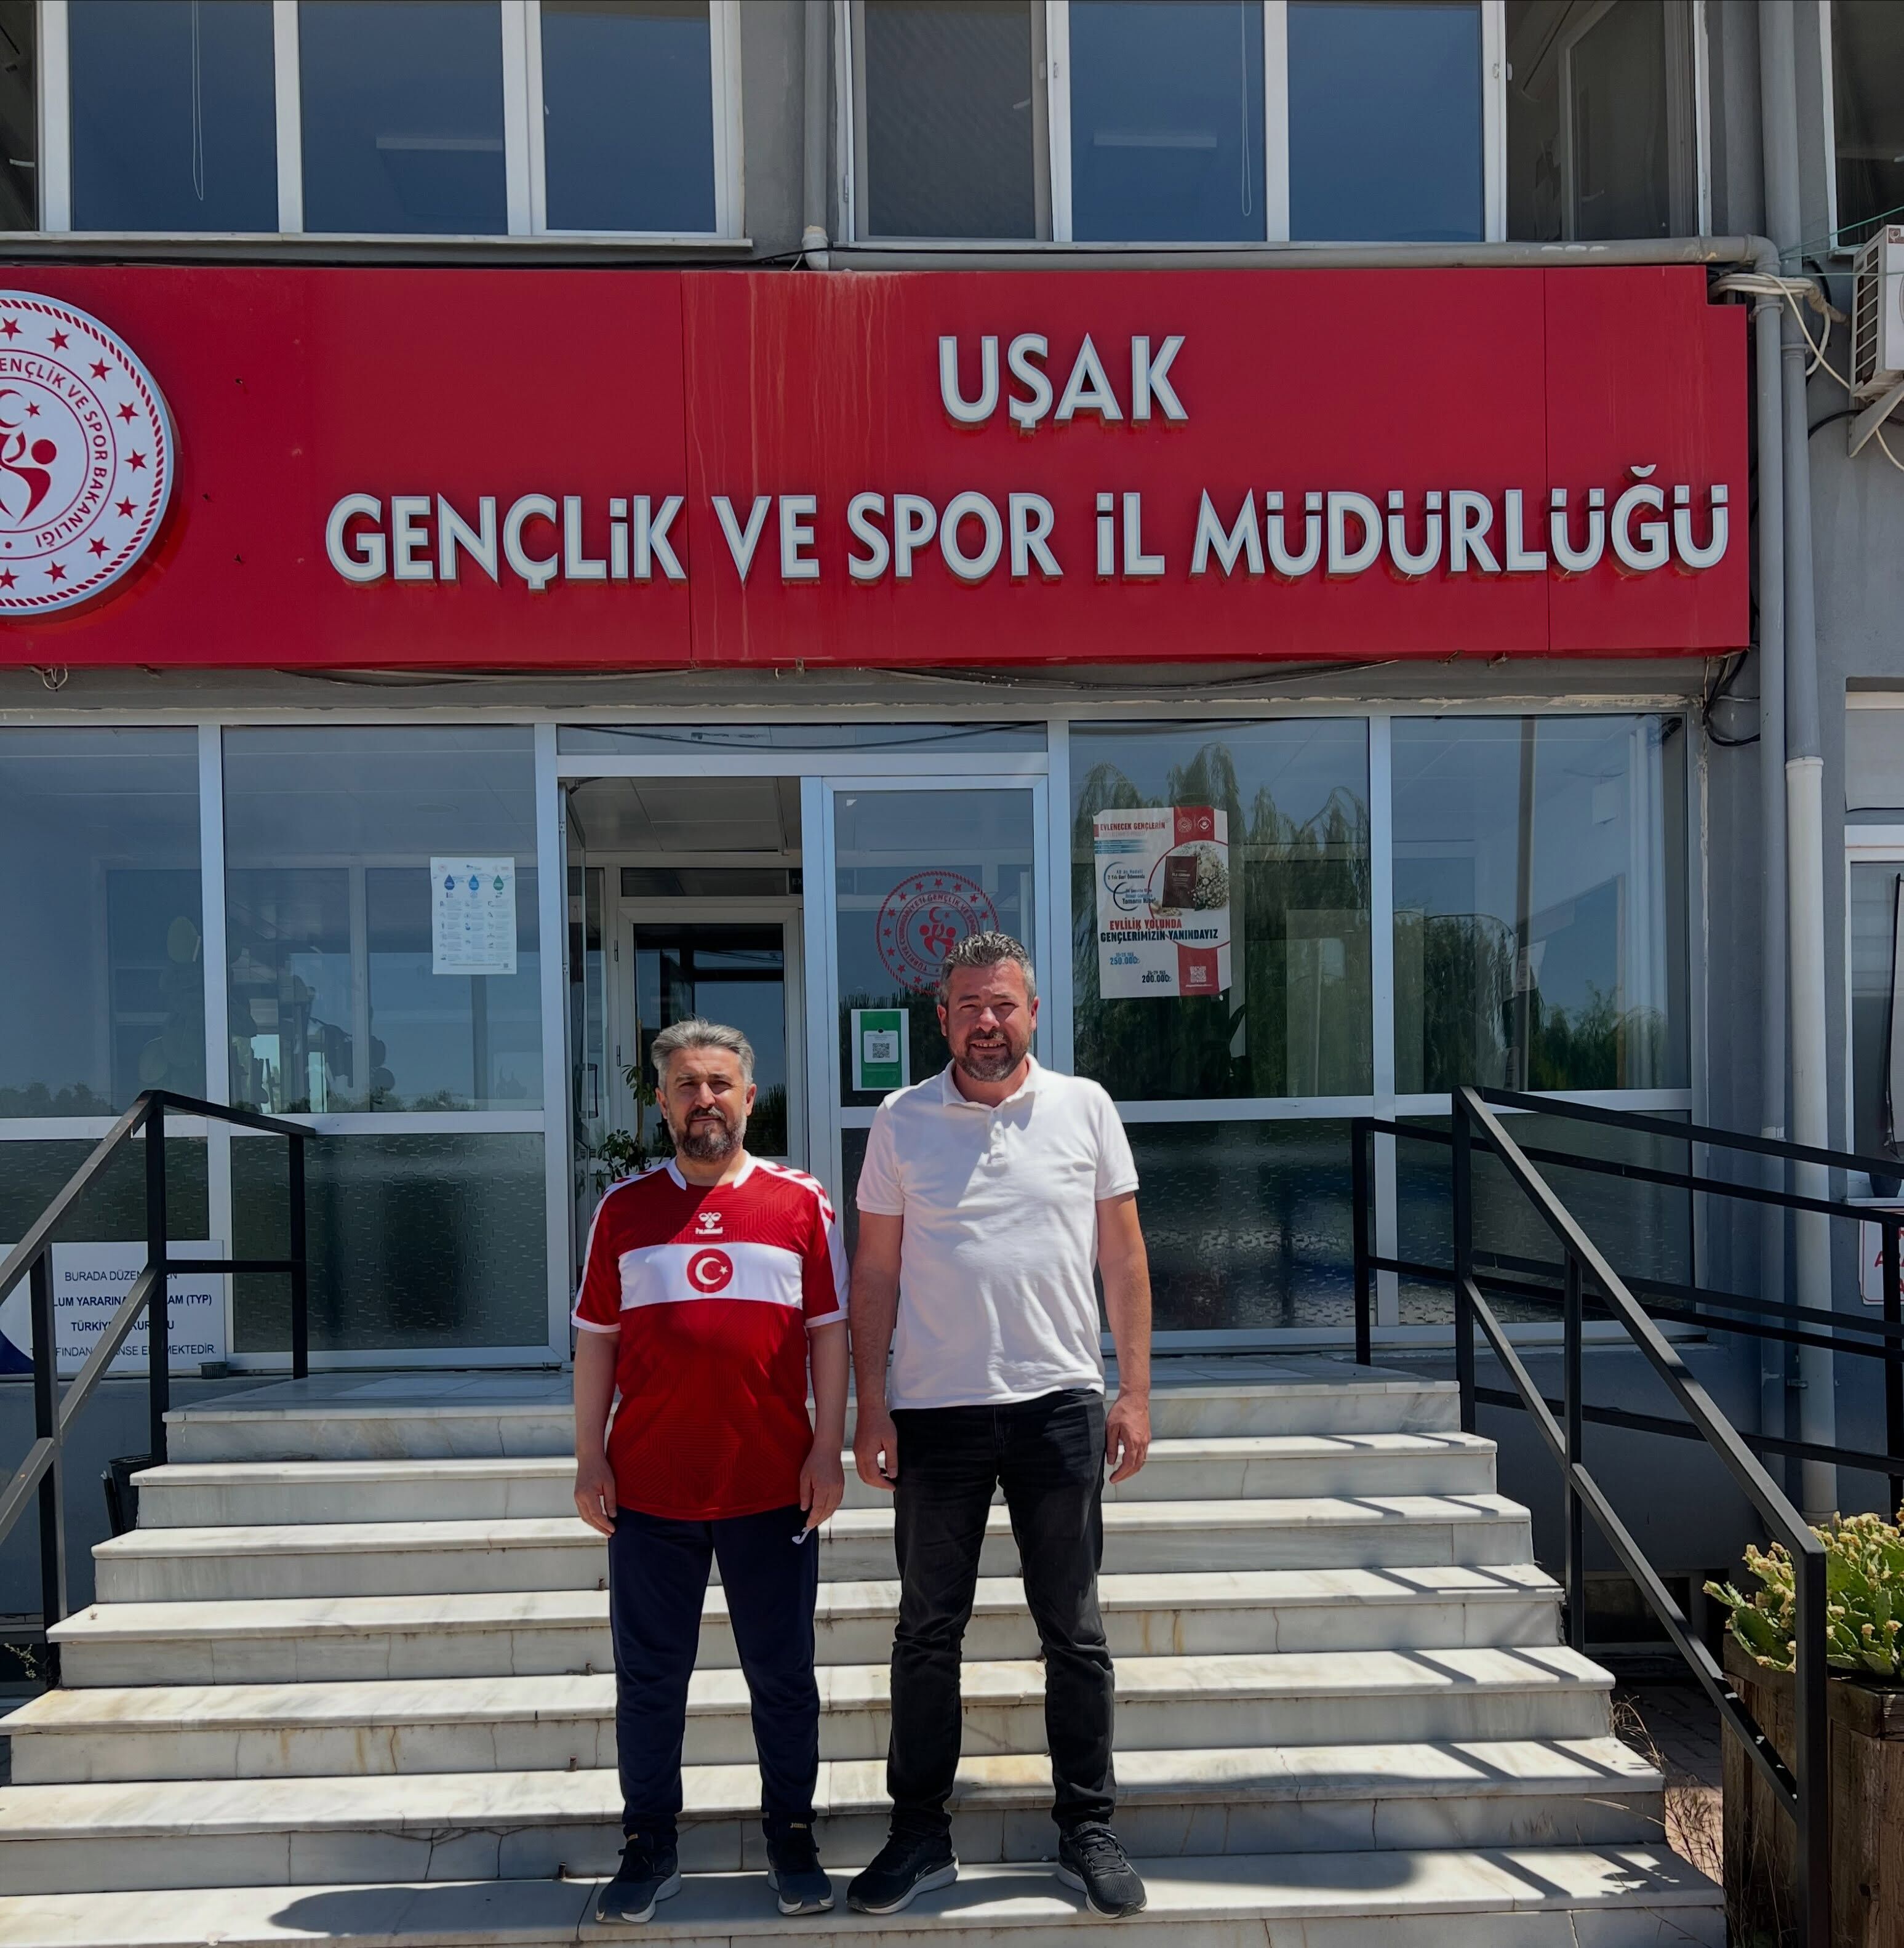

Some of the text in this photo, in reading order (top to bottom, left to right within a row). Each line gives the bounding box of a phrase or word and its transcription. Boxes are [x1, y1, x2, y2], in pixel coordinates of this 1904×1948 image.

[938, 332, 1189, 428] UŞAK
[0, 358, 108, 548] ENÇLİK VE SPOR BAKANLIĞI
[711, 495, 820, 583] VE
[847, 491, 1064, 579] SPOR
[1190, 463, 1729, 577] MÜDÜRLÜĞÜ
[1100, 820, 1166, 831] EVLENECEK GENÇLERİN
[1110, 917, 1182, 931] EVLİLİK YOLUNDA
[1100, 929, 1218, 944] GENÇLERİMİZİN YANINDAYIZ
[65, 1271, 107, 1281] BURADA
[186, 1294, 212, 1306] (TYP)
[71, 1320, 111, 1331] TÜRKİY
